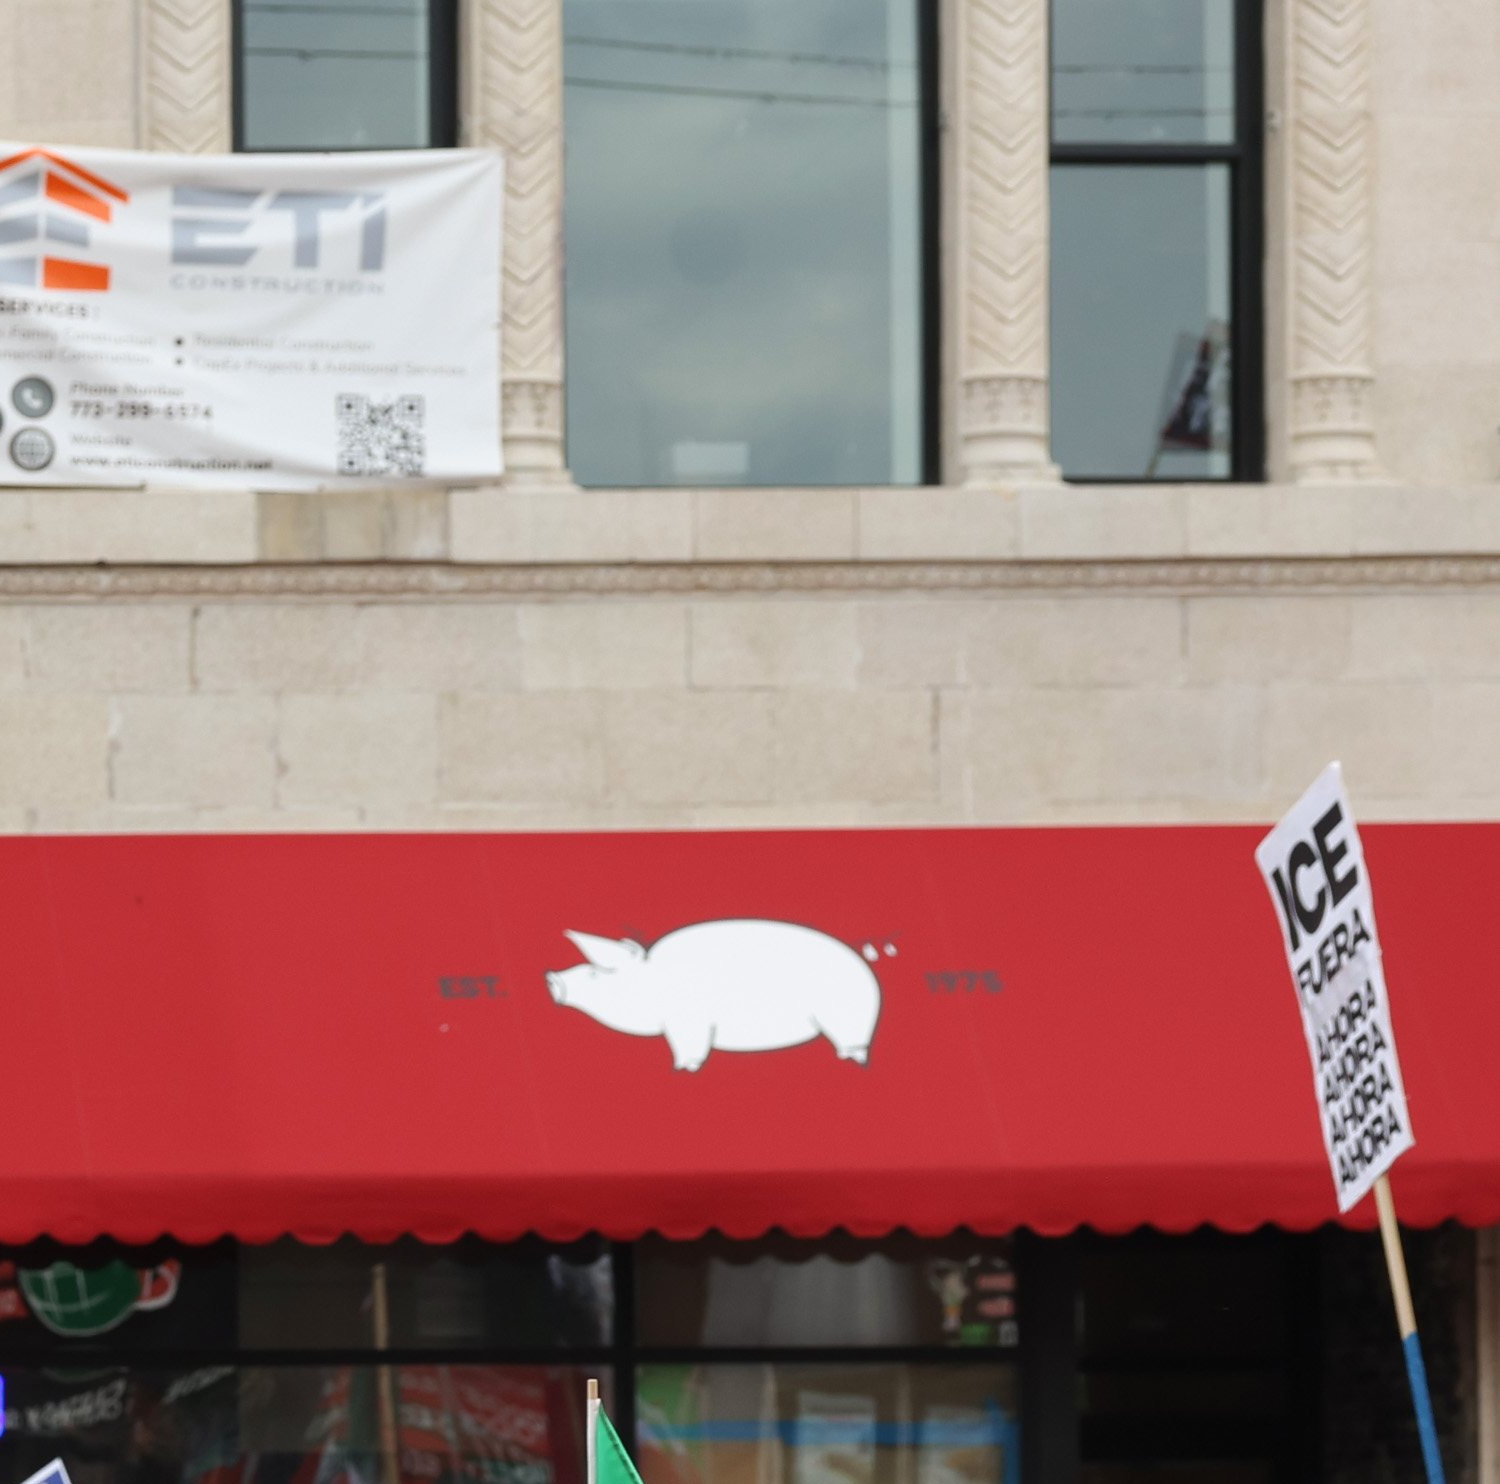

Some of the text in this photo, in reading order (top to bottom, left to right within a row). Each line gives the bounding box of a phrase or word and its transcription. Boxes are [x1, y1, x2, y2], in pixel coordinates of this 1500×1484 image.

[170, 273, 386, 296] CONSTRUCTION
[1272, 801, 1358, 952] ICE
[1297, 907, 1371, 995] FUERA
[1318, 978, 1377, 1065] AHORA
[1324, 1020, 1387, 1104] AHORA
[1332, 1060, 1394, 1145] AHORA
[1340, 1102, 1402, 1186] AHORA
